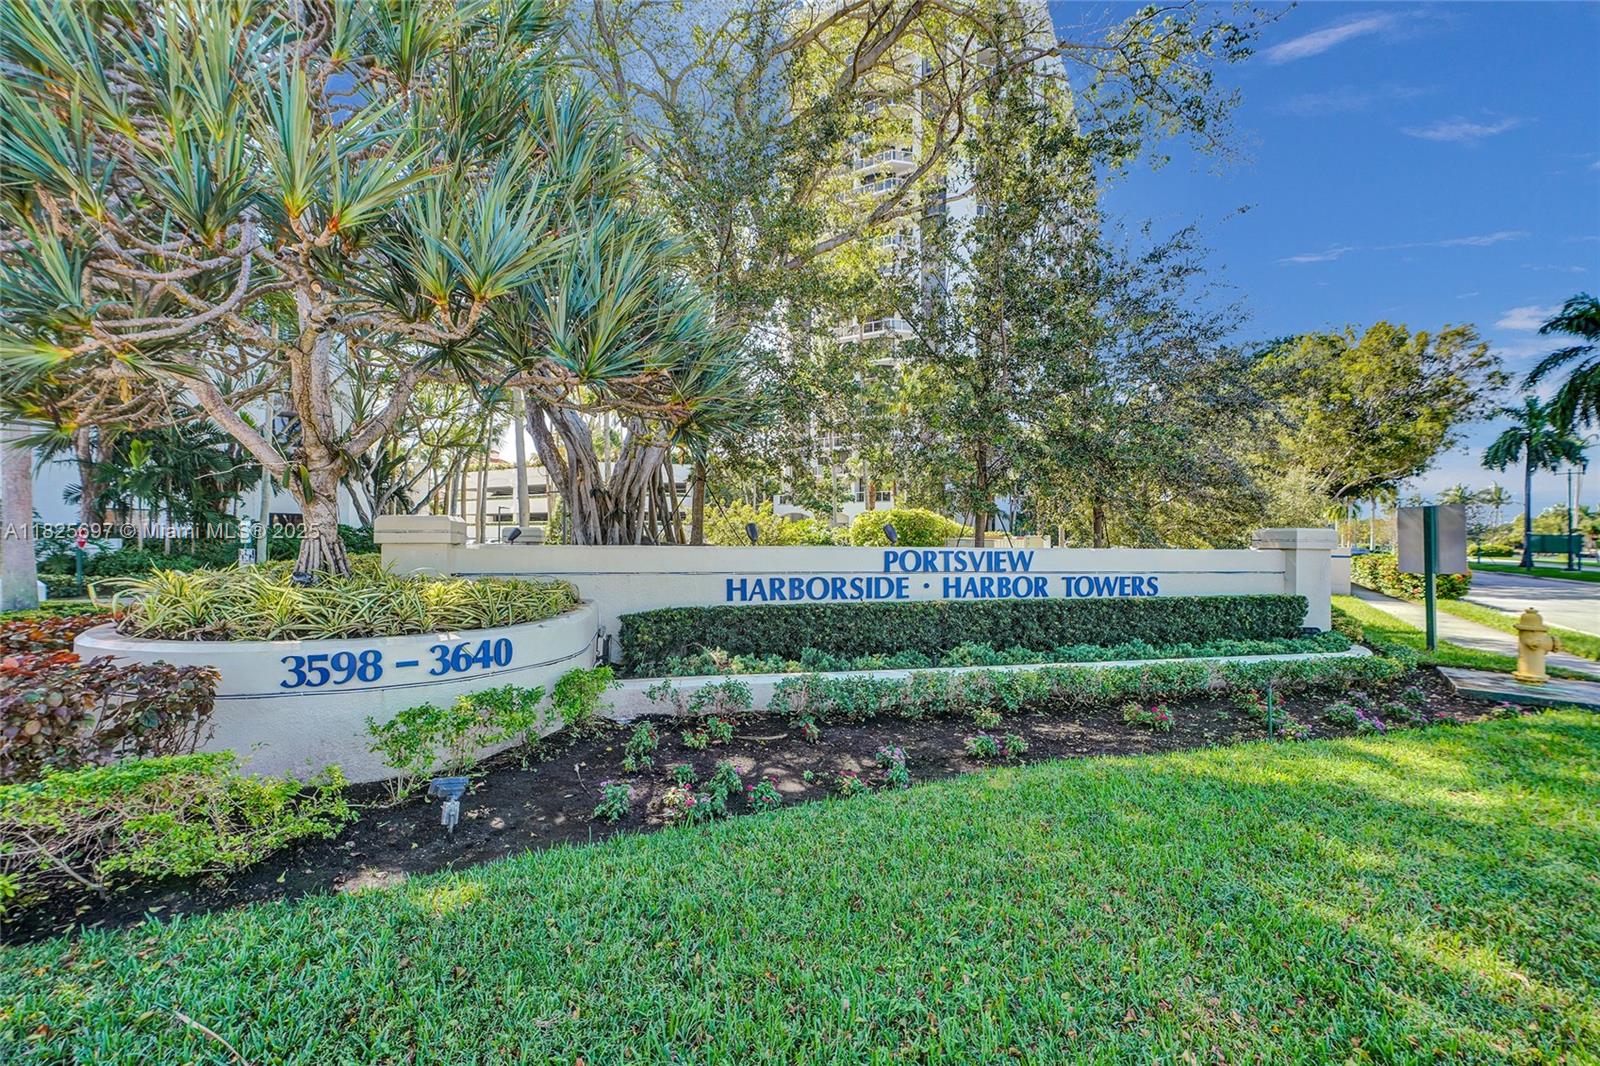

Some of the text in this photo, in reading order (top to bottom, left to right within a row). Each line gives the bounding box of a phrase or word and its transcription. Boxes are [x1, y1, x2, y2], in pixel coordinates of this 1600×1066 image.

[884, 550, 1034, 573] PORTSVIEW
[726, 576, 910, 602] HARBORSIDE
[943, 576, 1049, 599] HARBOR
[1061, 576, 1159, 598] TOWERS
[280, 649, 384, 689] 3598
[429, 638, 514, 676] 3640
